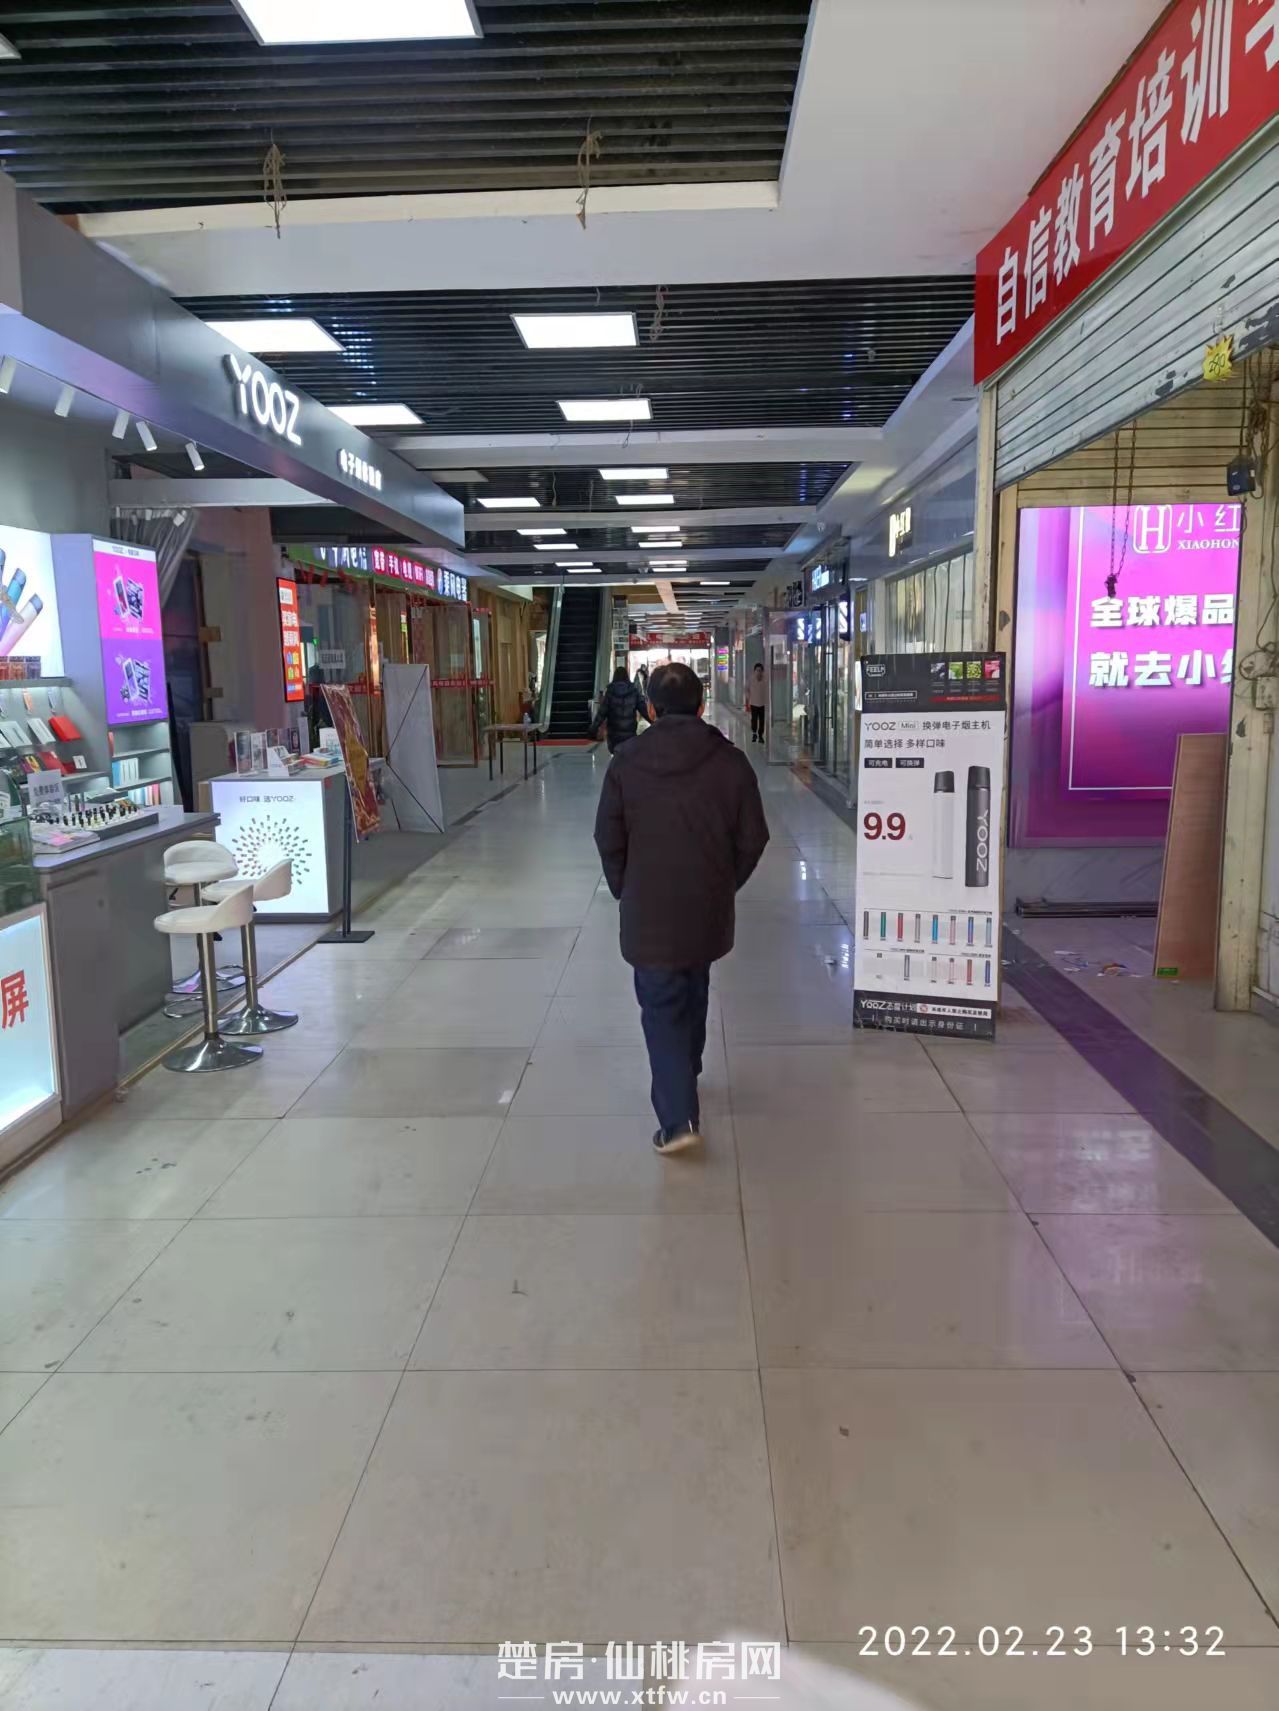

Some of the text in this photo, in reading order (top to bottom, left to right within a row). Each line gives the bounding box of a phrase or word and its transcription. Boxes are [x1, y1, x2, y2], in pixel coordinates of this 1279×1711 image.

[996, 0, 1279, 346] 自信教育培训
[228, 353, 303, 447] YOOZ
[1177, 504, 1241, 533] 小红
[1090, 594, 1234, 628] 全球爆品
[864, 720, 991, 732] YOOZ Mini 换弹电子烟主机
[864, 739, 946, 749] 简单选择 多样口味
[863, 812, 906, 840] 9.9
[976, 809, 989, 872] YOOZ
[1, 969, 29, 1030] 屏
